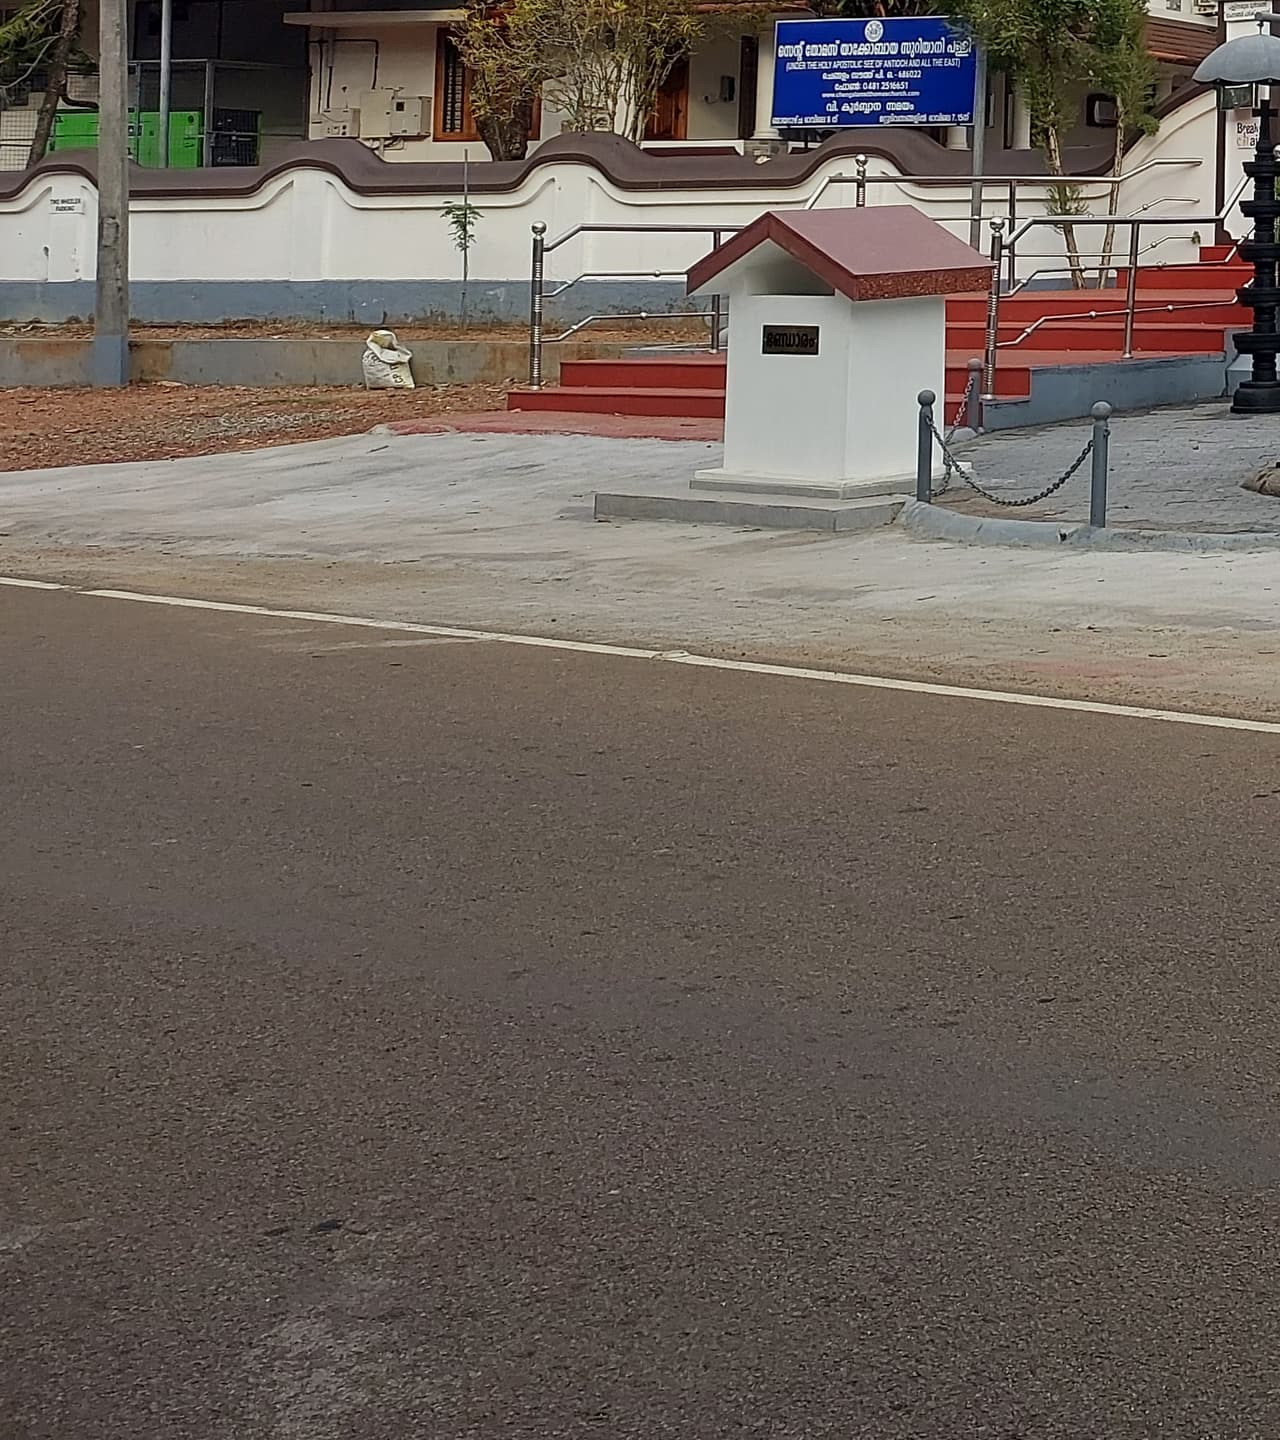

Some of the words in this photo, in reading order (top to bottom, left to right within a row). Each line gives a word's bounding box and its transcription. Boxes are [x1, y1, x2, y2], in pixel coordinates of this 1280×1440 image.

[805, 40, 840, 57] തോമസ്
[840, 42, 899, 57] യാക്കോബായ
[900, 37, 945, 58] സുറിയാനി
[947, 37, 972, 57] പള്ളി
[807, 61, 818, 70] THE
[818, 61, 832, 70] HOLY
[832, 60, 863, 69] APOSTOLIC
[864, 60, 874, 69] SEE
[875, 59, 883, 68] OF
[883, 59, 908, 68] ANTIOCH
[908, 59, 920, 67] AND
[920, 58, 931, 67] ALL
[932, 58, 943, 67] THE
[944, 58, 961, 69] EAST)
